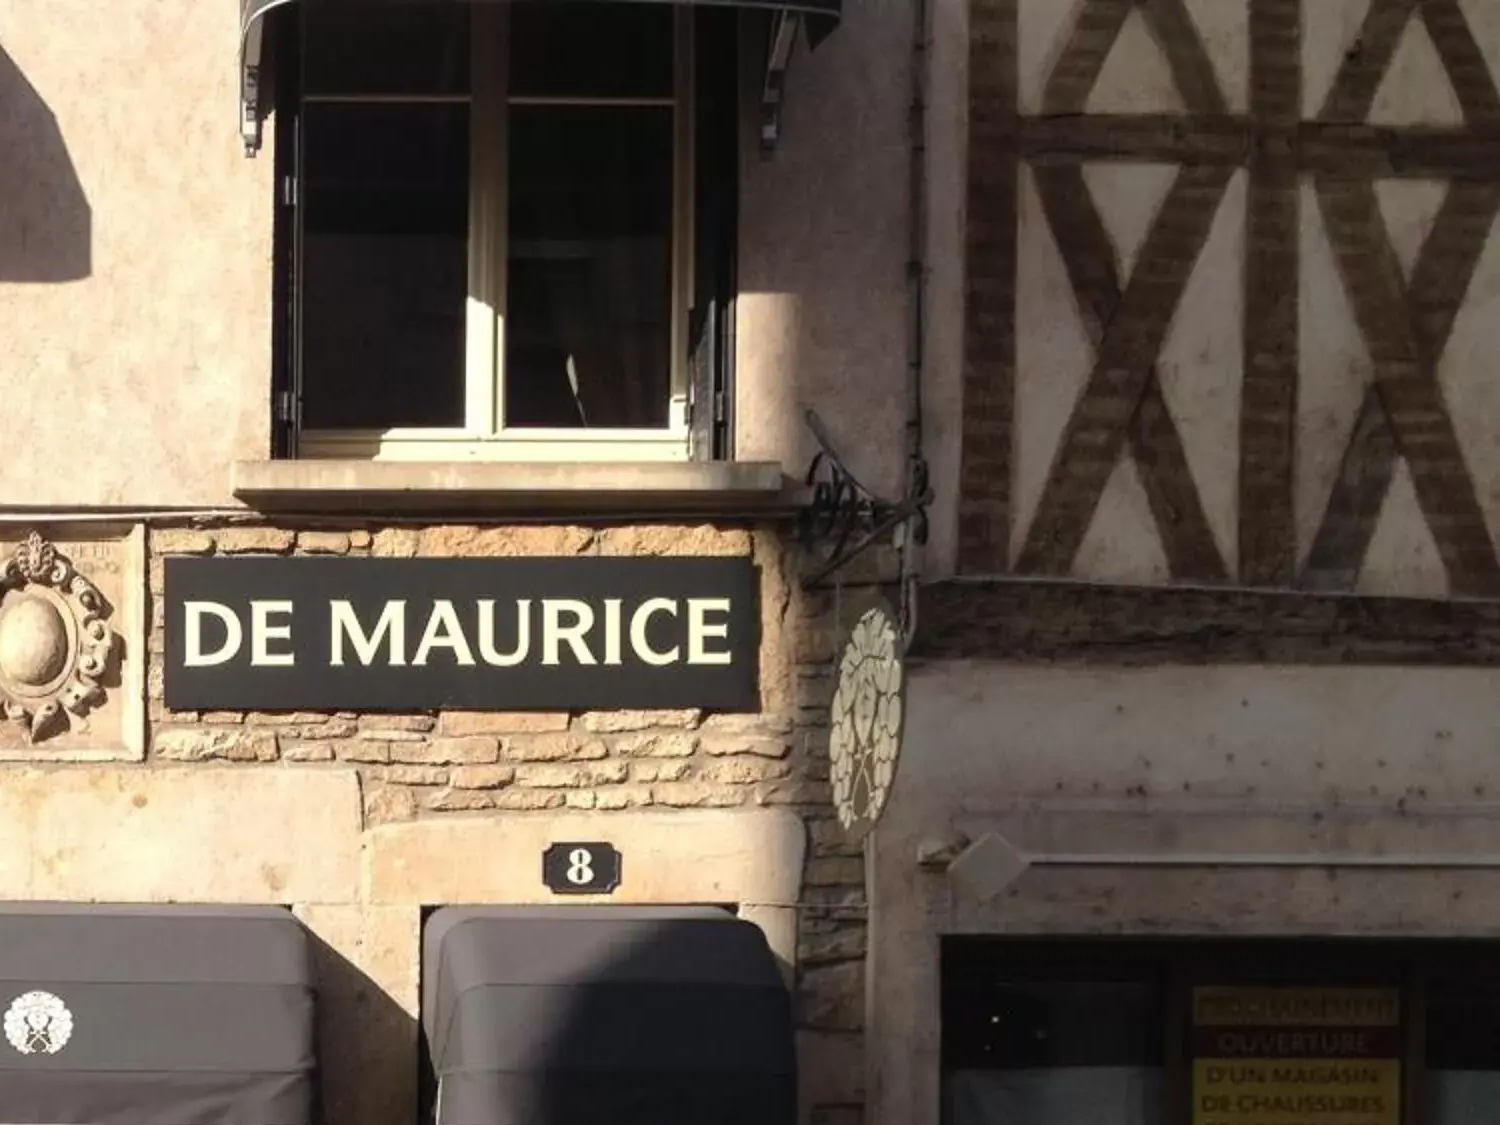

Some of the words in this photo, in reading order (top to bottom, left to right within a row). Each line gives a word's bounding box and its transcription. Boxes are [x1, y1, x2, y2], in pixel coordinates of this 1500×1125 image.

[183, 599, 296, 668] DE
[328, 597, 733, 668] MAURICE
[564, 849, 595, 884] 8
[1217, 1031, 1369, 1054] OUVERTURE
[1273, 1068, 1379, 1085] MAGASIN
[1236, 1095, 1385, 1113] CHAUSSURES
